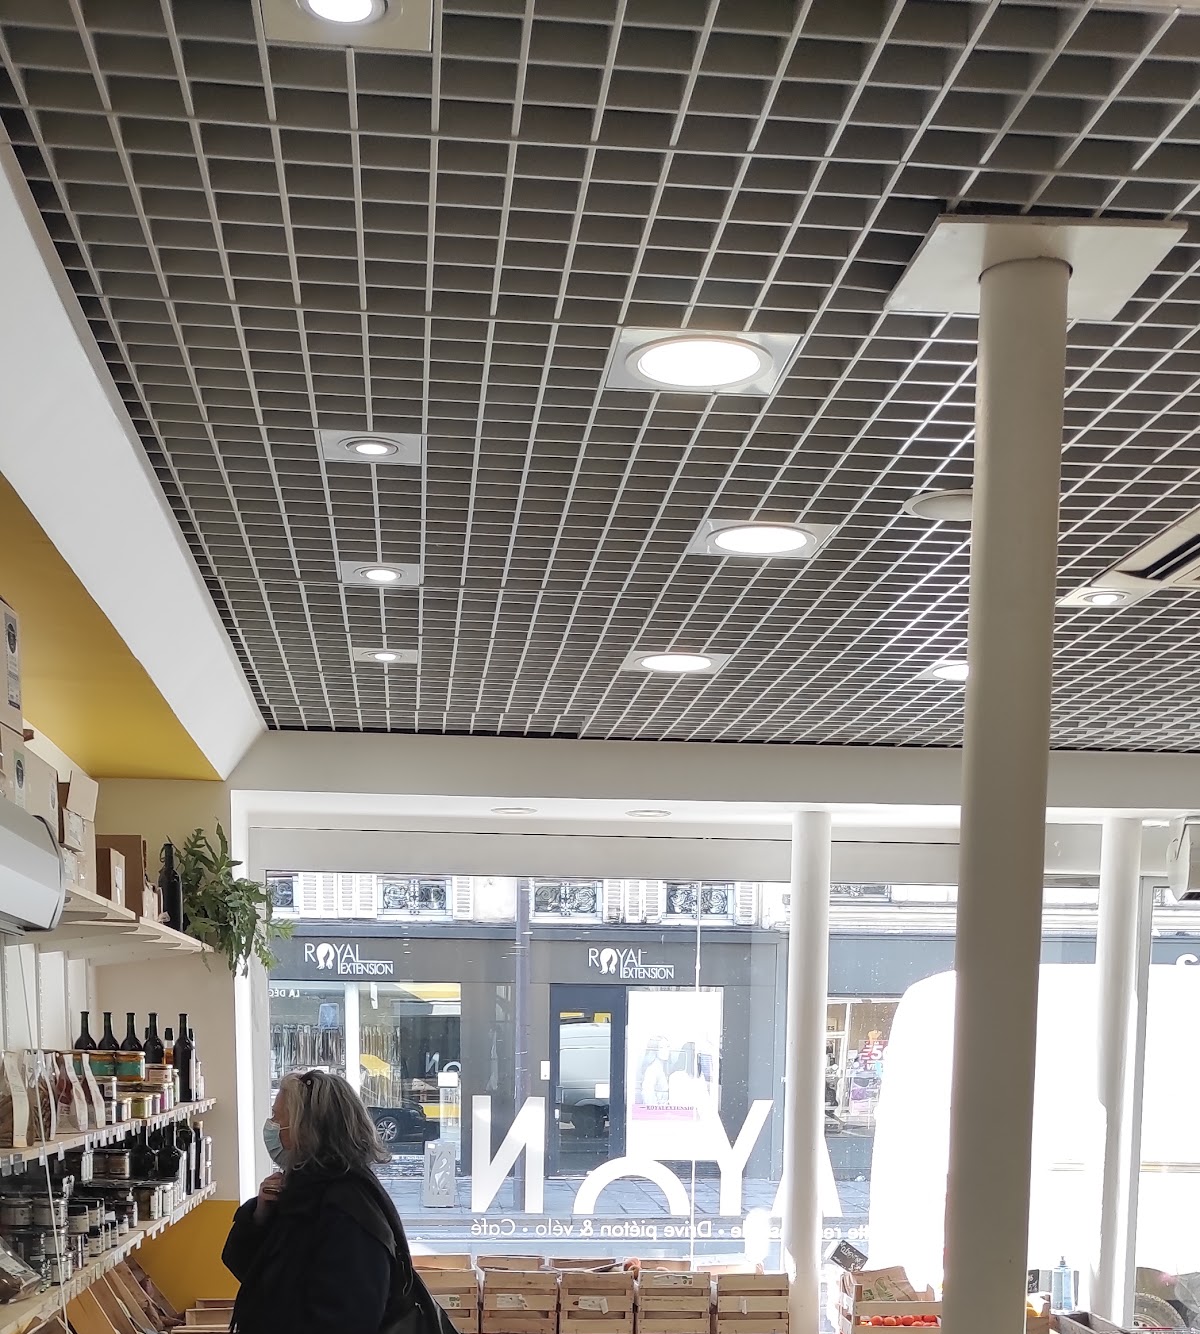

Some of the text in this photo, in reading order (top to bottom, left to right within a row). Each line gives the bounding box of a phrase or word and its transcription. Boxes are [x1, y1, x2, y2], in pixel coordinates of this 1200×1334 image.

[304, 942, 384, 973] ROYAL
[588, 948, 662, 977] ROYAL
[341, 963, 393, 975] EXTENSION
[623, 967, 674, 979] EXTENSION
